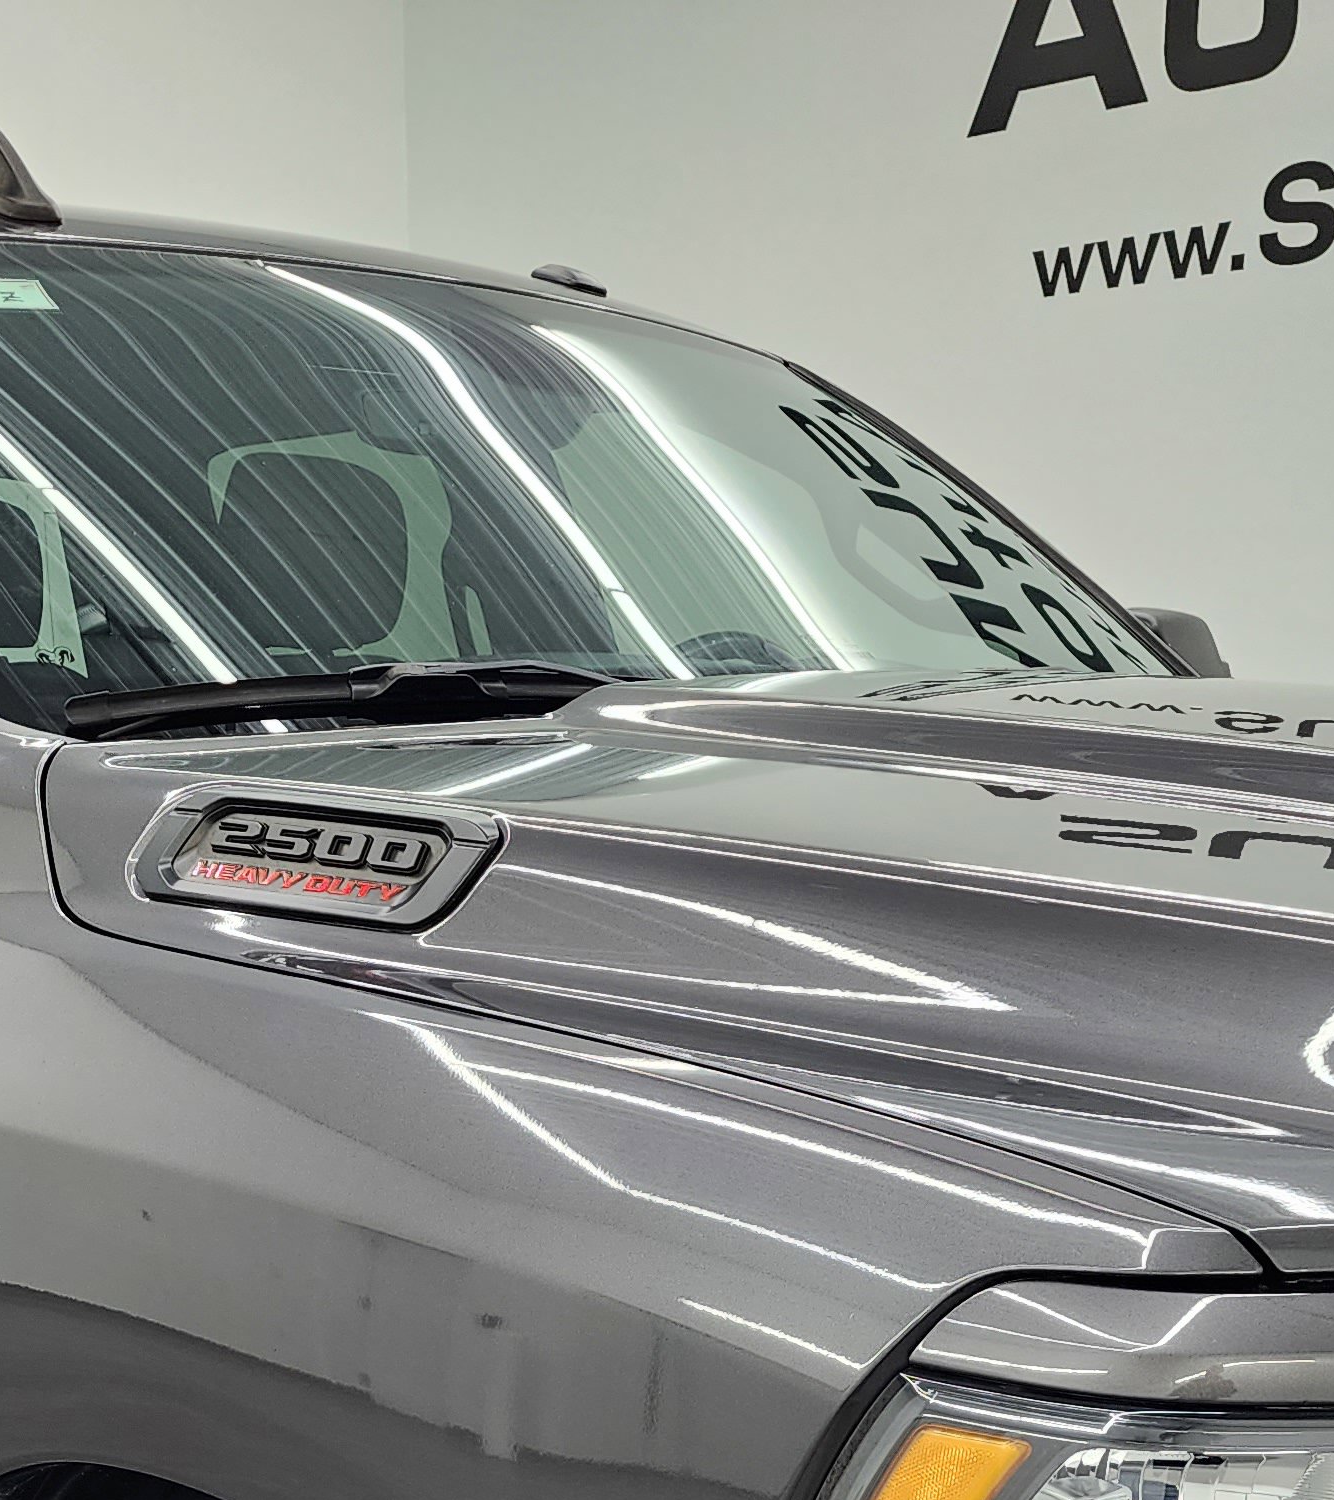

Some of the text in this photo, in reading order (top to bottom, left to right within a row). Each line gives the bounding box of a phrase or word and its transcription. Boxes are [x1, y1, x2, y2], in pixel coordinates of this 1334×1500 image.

[211, 818, 432, 876] 2500
[193, 858, 407, 901] HEAVY DUTY
